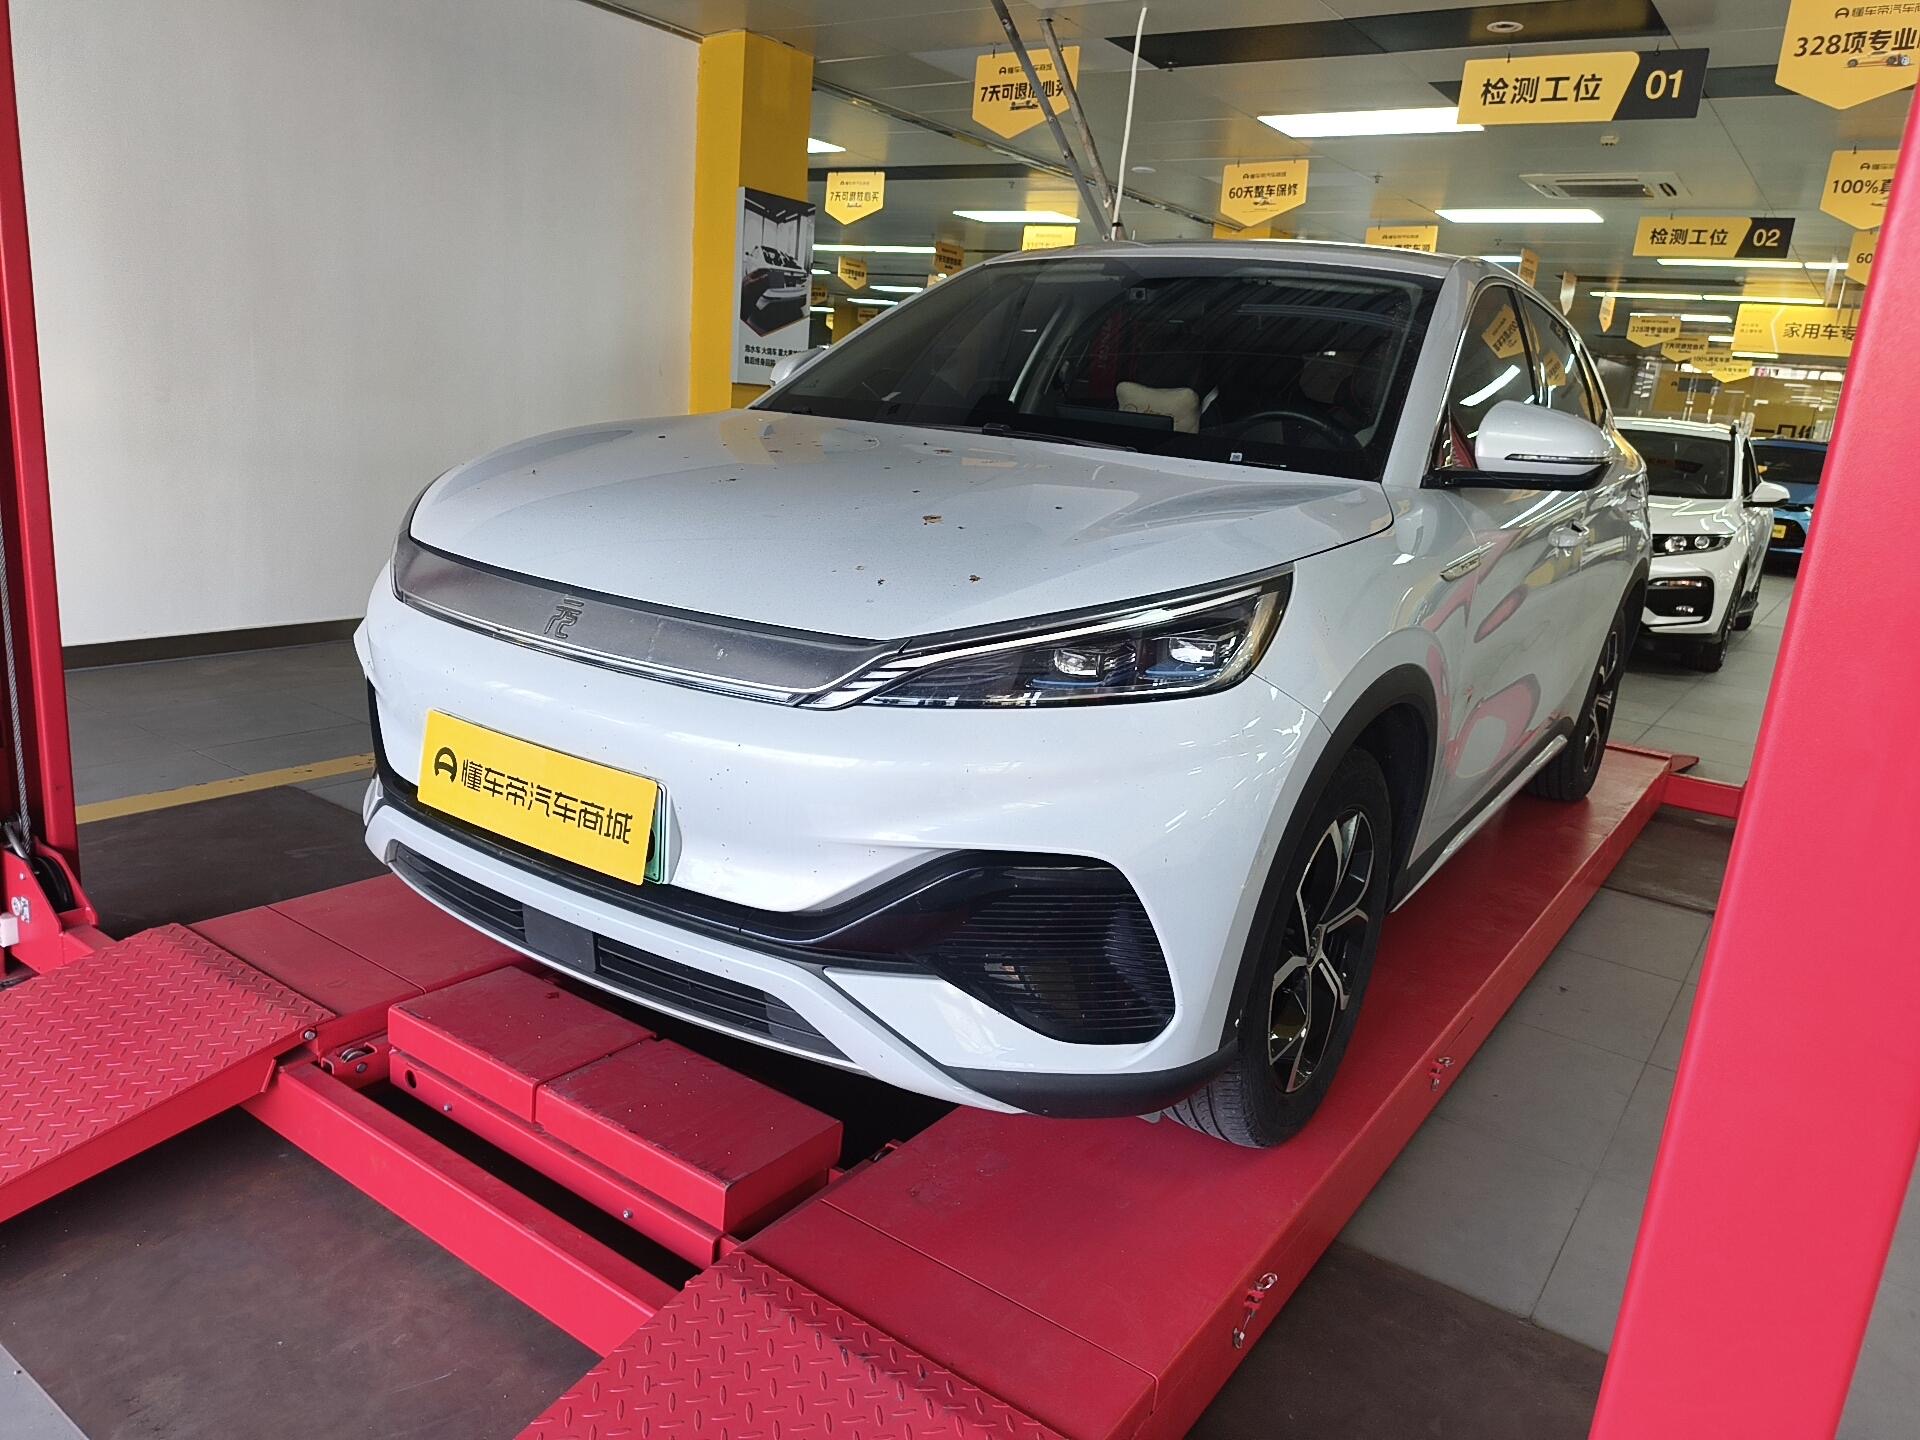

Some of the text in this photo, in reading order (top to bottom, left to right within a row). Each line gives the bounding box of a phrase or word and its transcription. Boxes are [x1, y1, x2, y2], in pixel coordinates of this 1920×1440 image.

[1793, 27, 1920, 57] 328项专业
[1479, 69, 1684, 106] 检测工位 01
[1229, 183, 1299, 199] 60天整车保修
[1650, 228, 1781, 247] 检测工位 02
[461, 758, 634, 845] 懂车帝汽车商城
